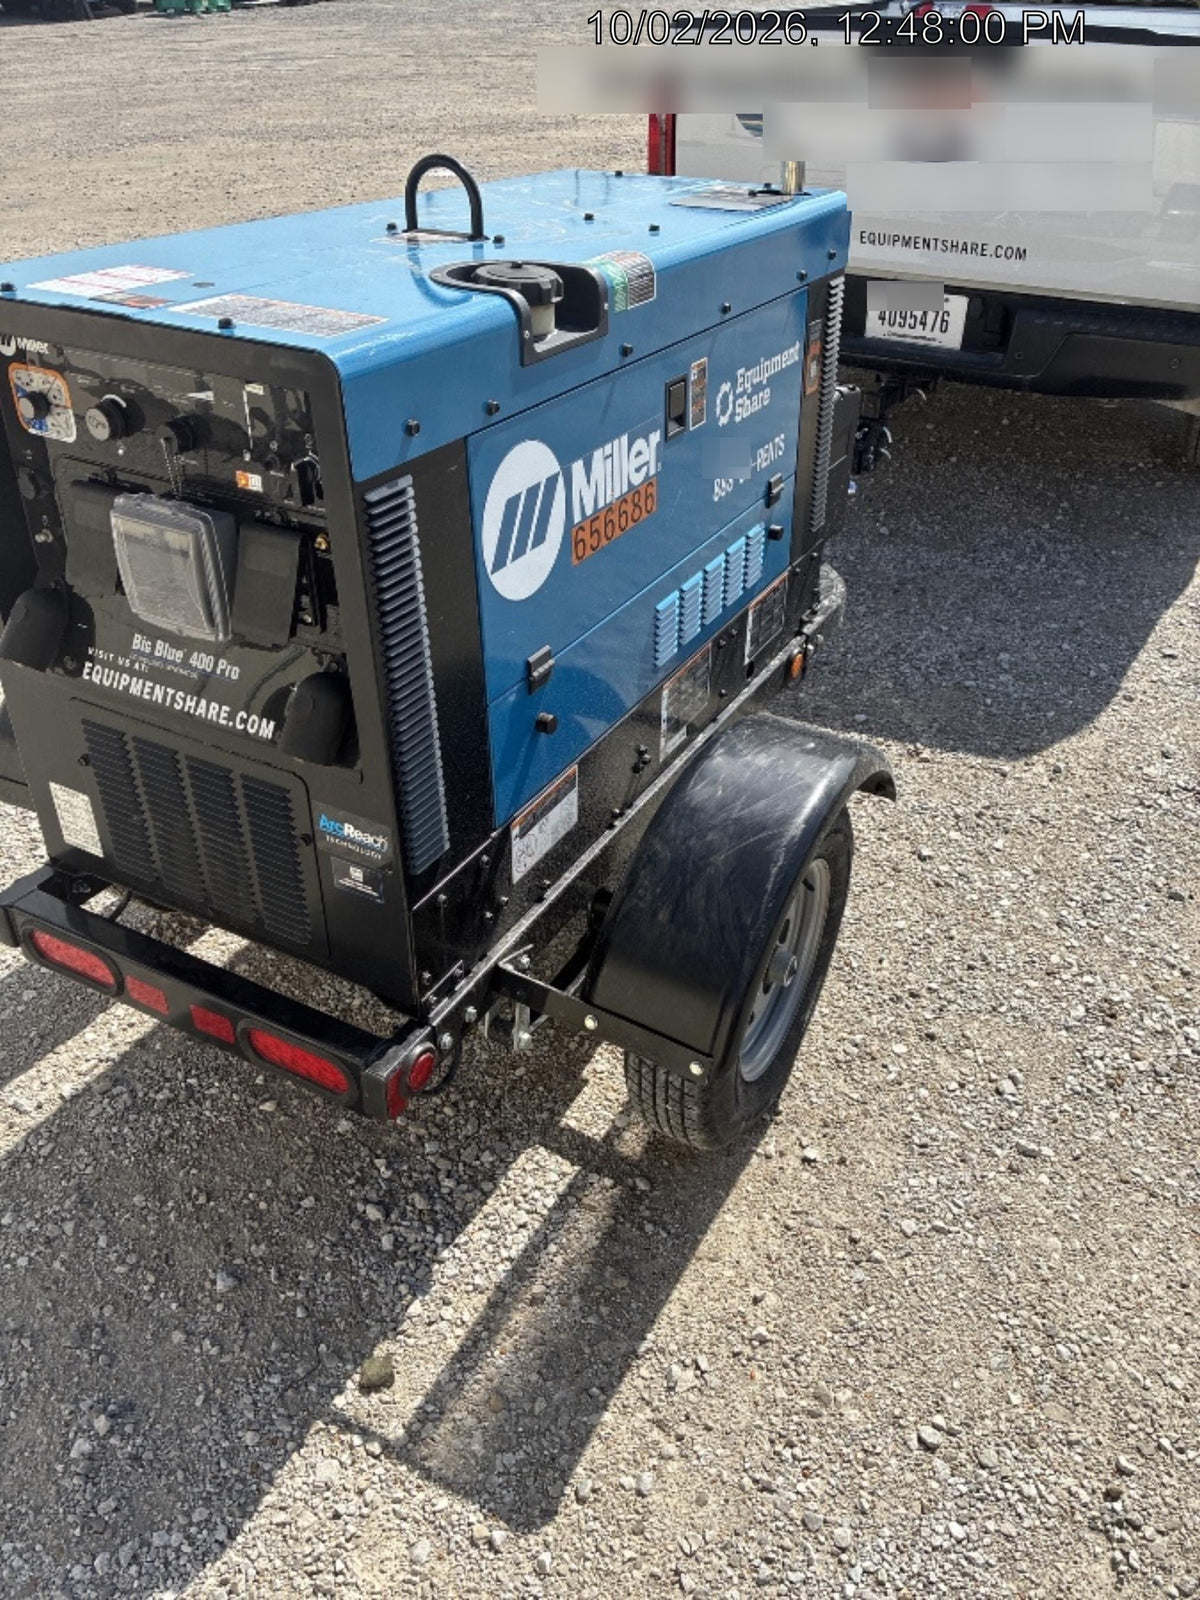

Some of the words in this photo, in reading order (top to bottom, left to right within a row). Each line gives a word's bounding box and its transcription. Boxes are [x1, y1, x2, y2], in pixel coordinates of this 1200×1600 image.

[859, 230, 1028, 262] EQUIPMENTSHARE.COM
[735, 340, 800, 395] Equipment
[734, 387, 771, 423] Share
[571, 428, 661, 525] Miller
[573, 480, 655, 561] 656686
[88, 646, 114, 663] VISIT
[118, 655, 131, 668] US
[132, 633, 152, 654] Big
[154, 639, 184, 664] Blue
[189, 651, 214, 673] 400
[216, 658, 241, 681] Pro
[82, 660, 277, 740] EQUIPMENTSHARE.COM
